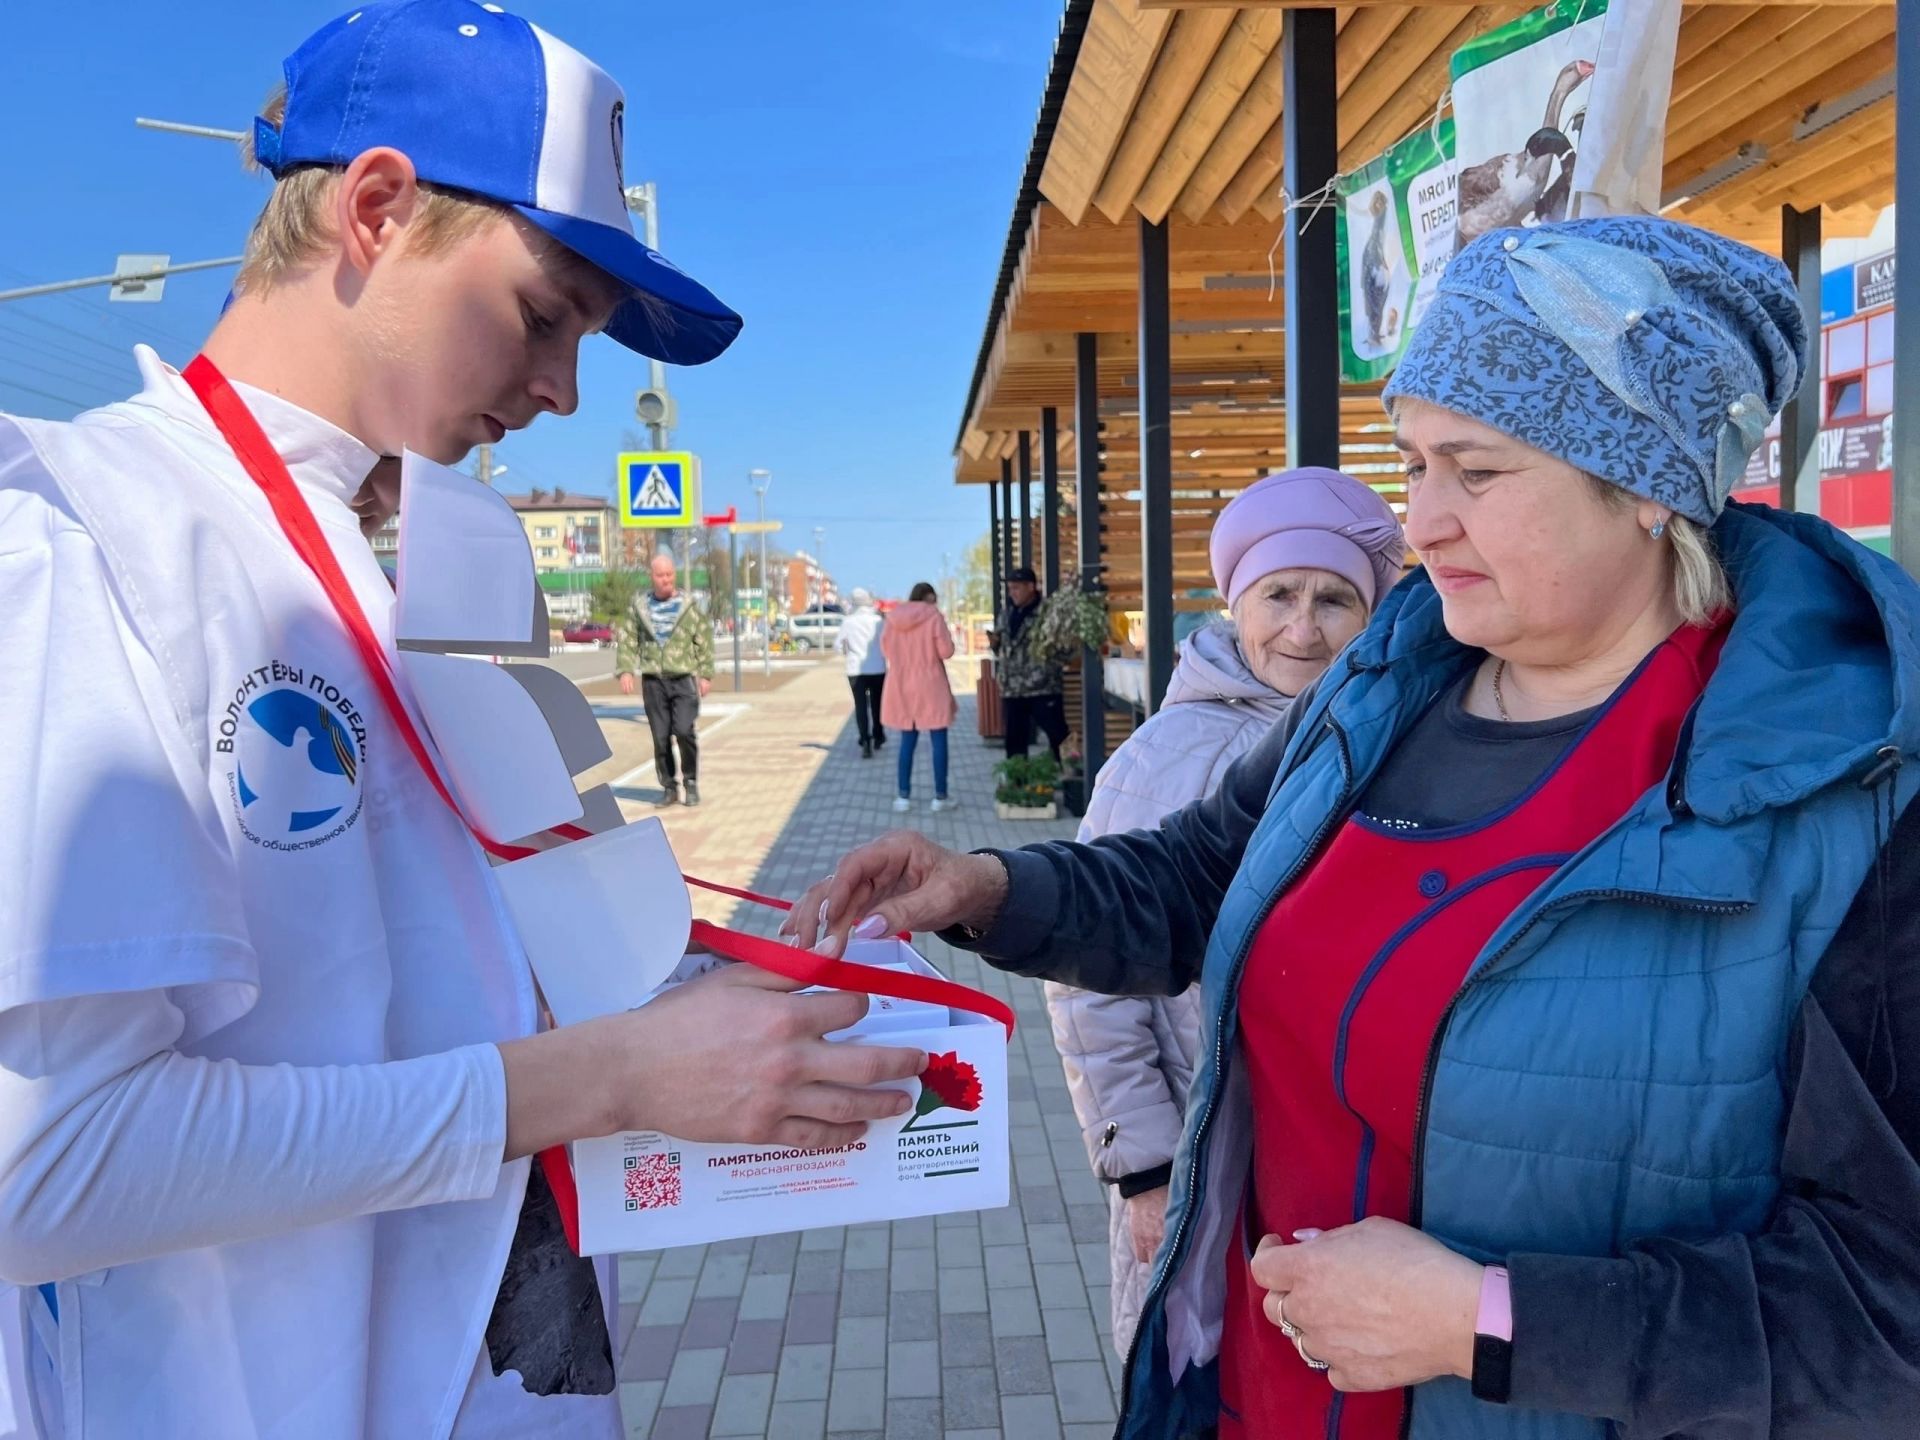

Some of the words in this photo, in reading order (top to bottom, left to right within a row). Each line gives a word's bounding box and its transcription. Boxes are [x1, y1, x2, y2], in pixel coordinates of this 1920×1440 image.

[216, 660, 303, 753] ВОЛОНТЁРЫ
[262, 825, 346, 852] общественное
[898, 1133, 951, 1147] ПАМЯТЬ
[898, 1141, 979, 1161] ПОКОЛЕНИЙ
[731, 1158, 846, 1179] #краснаягвоздика
